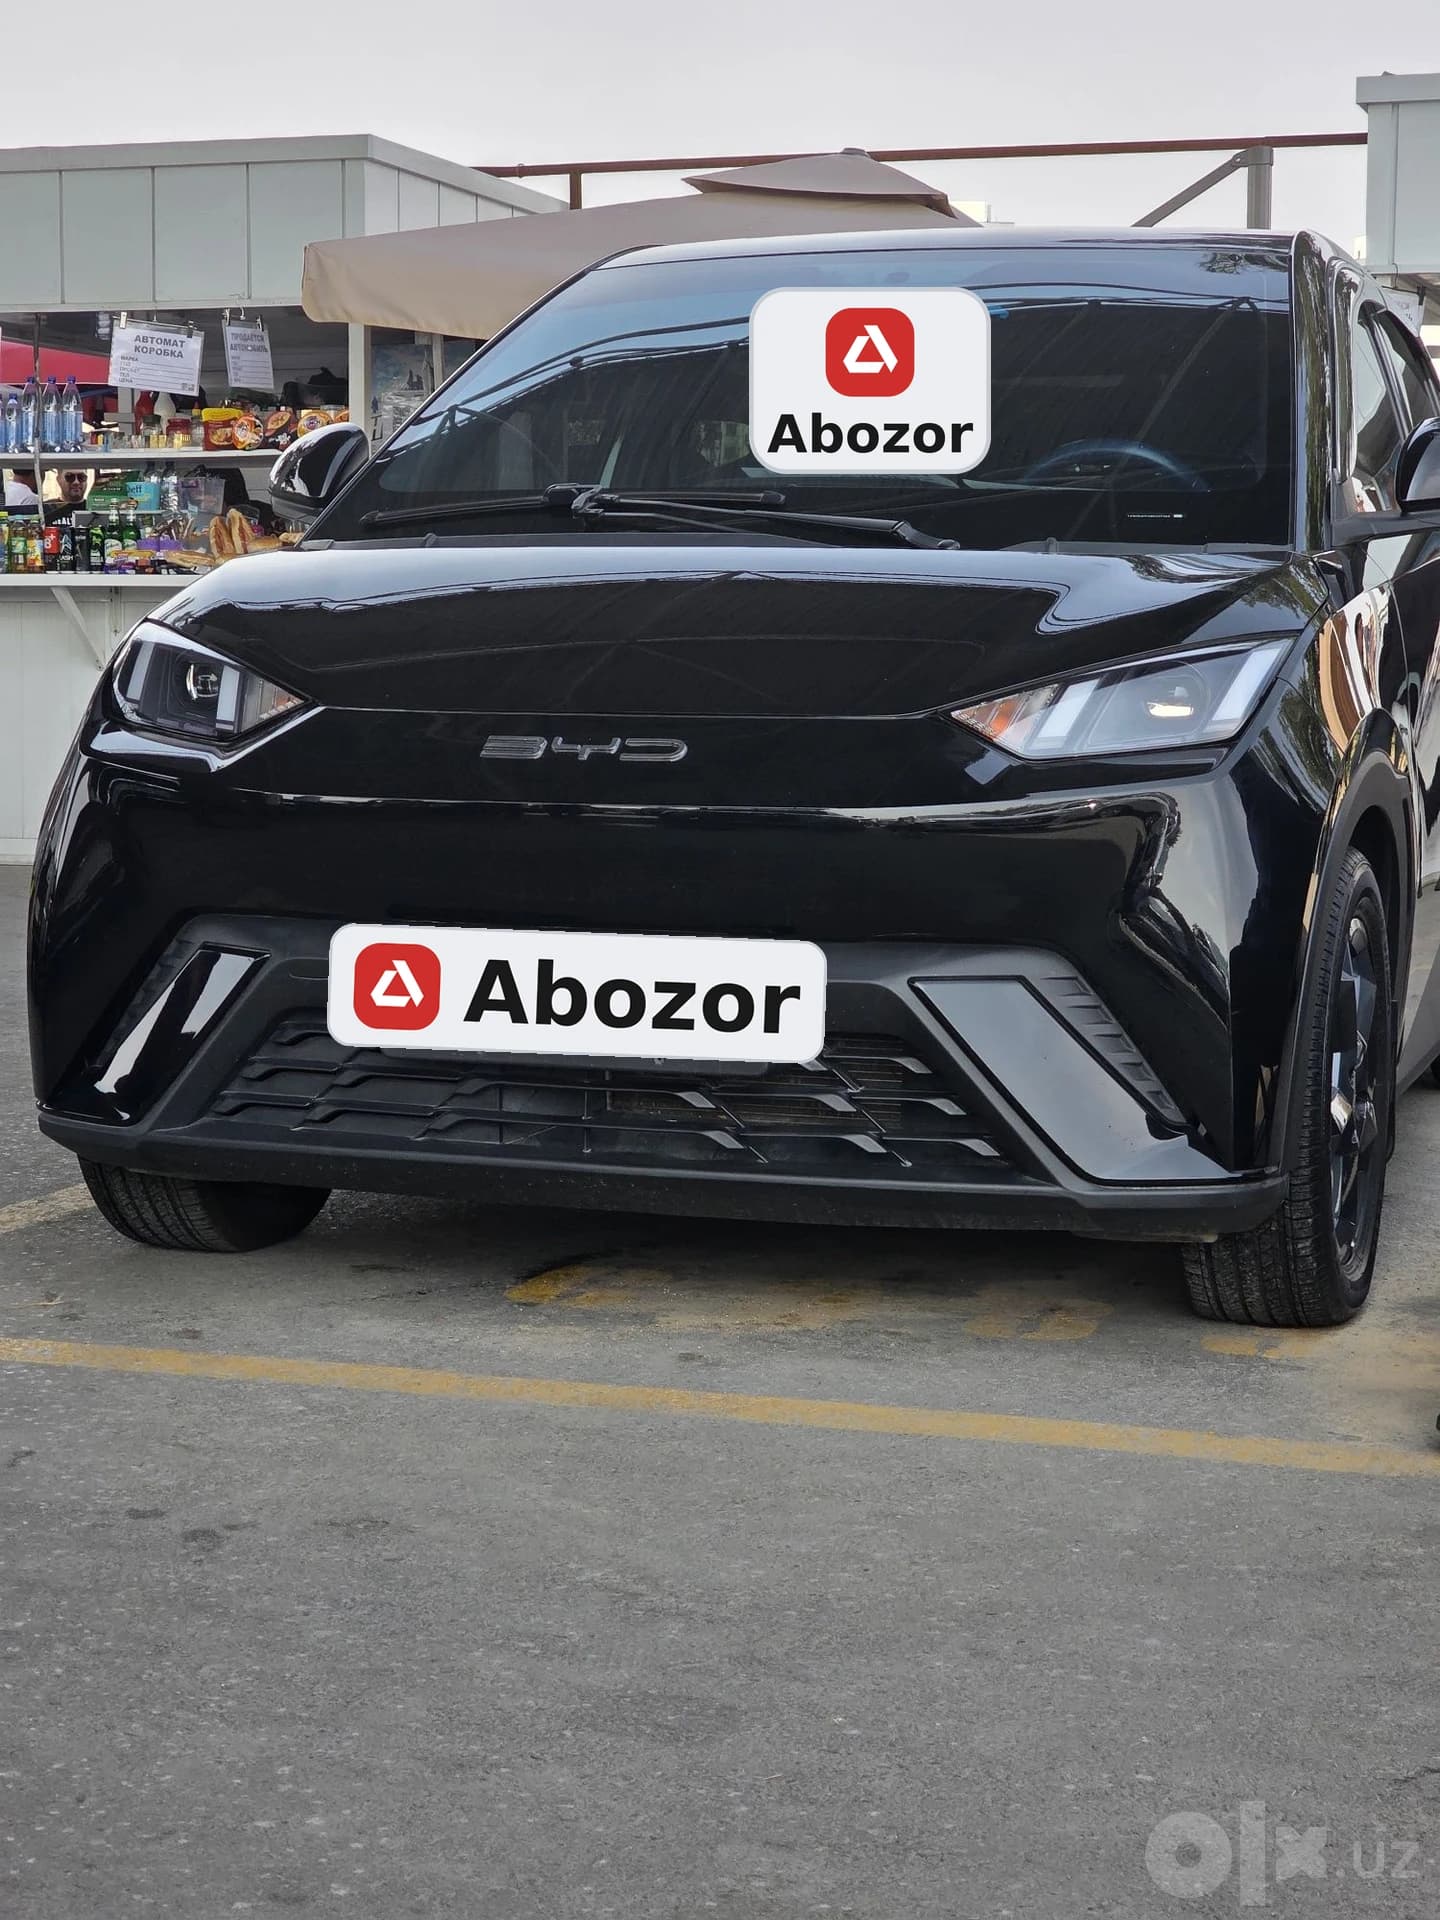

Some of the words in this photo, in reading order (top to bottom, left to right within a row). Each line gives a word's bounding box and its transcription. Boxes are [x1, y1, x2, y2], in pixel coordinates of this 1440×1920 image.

[134, 334, 186, 348] АВТОМАТ
[134, 345, 184, 358] КОРОБКА
[480, 735, 687, 762] BYD
